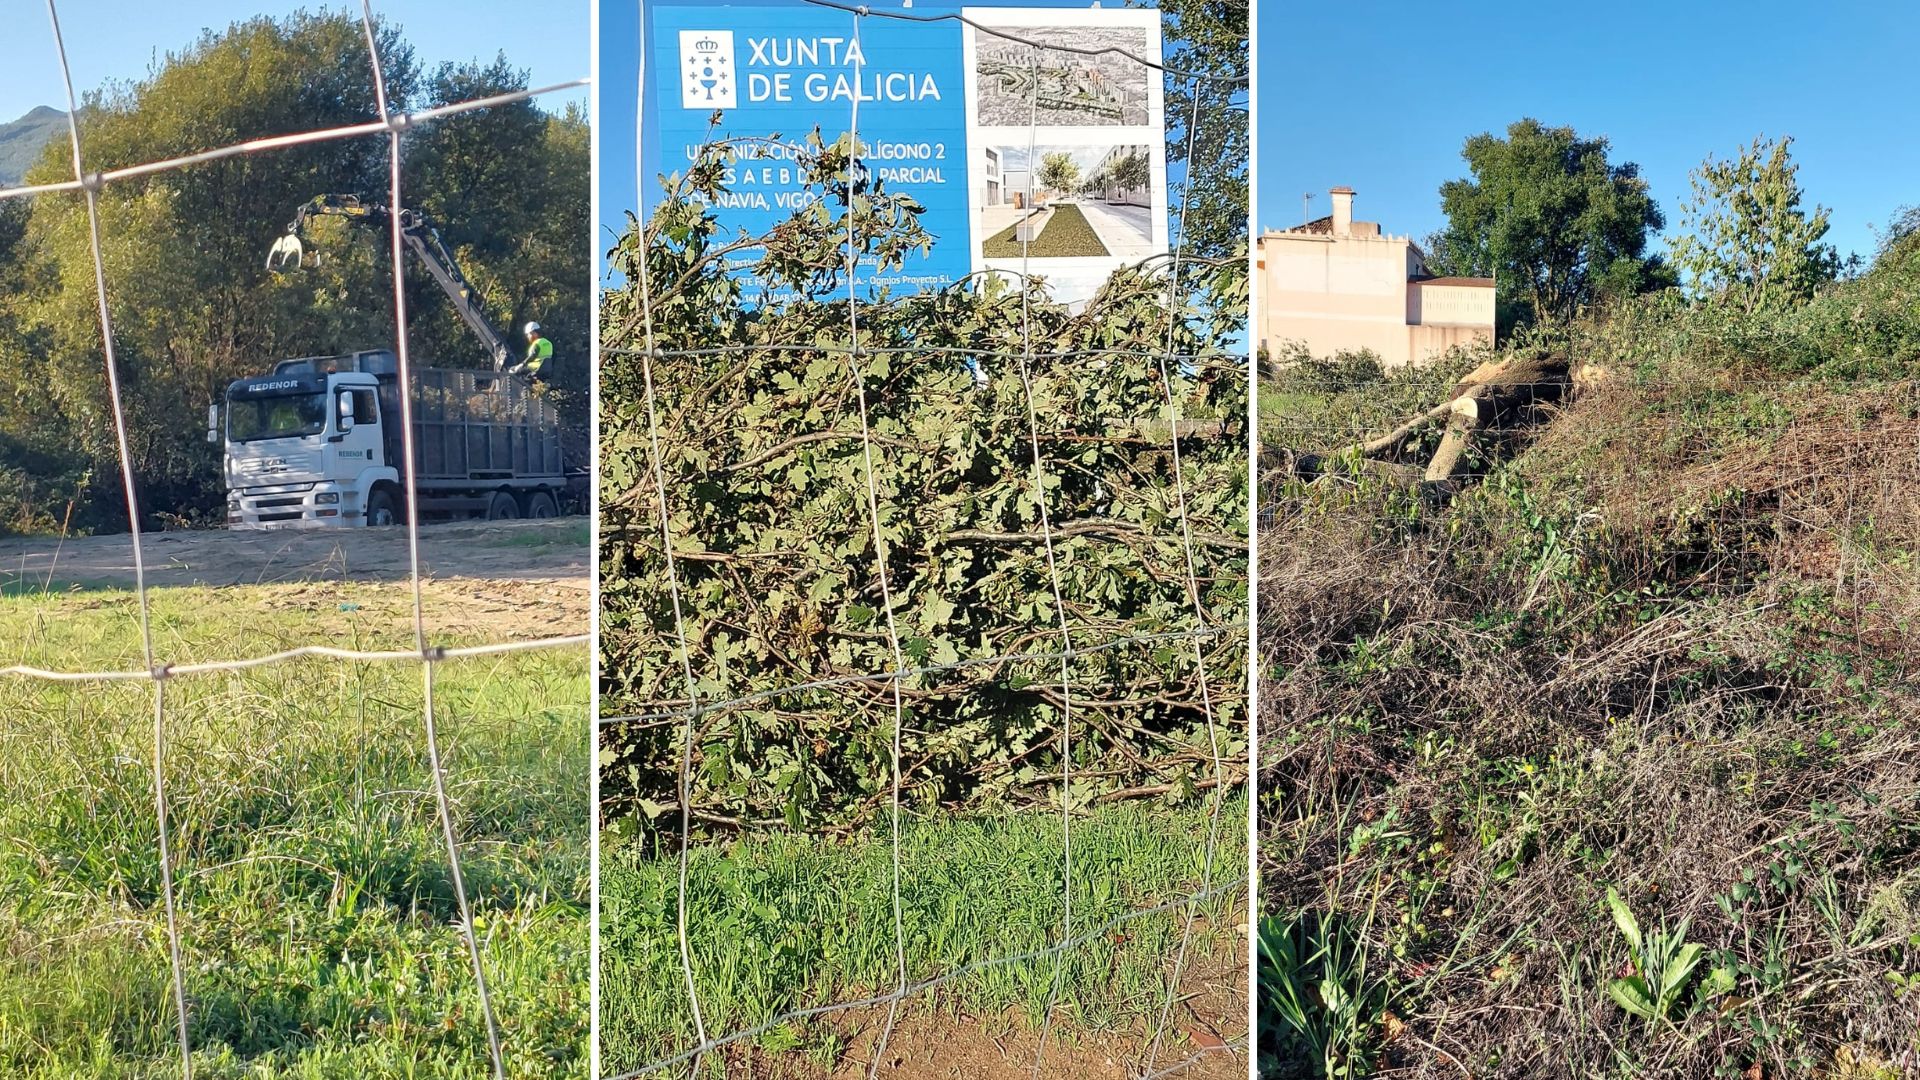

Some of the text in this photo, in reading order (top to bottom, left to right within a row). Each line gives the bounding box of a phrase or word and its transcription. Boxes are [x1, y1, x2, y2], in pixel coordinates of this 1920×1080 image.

[748, 37, 867, 66] XUNTA
[748, 72, 941, 102] DE GALICIA
[935, 143, 946, 159] 2
[743, 168, 756, 184] A
[762, 168, 773, 184] E
[780, 168, 791, 184] B
[879, 167, 946, 184] PARCIAL
[716, 192, 771, 211] NAVIA,
[774, 191, 816, 209] VIGO
[248, 380, 298, 392] REDENOR
